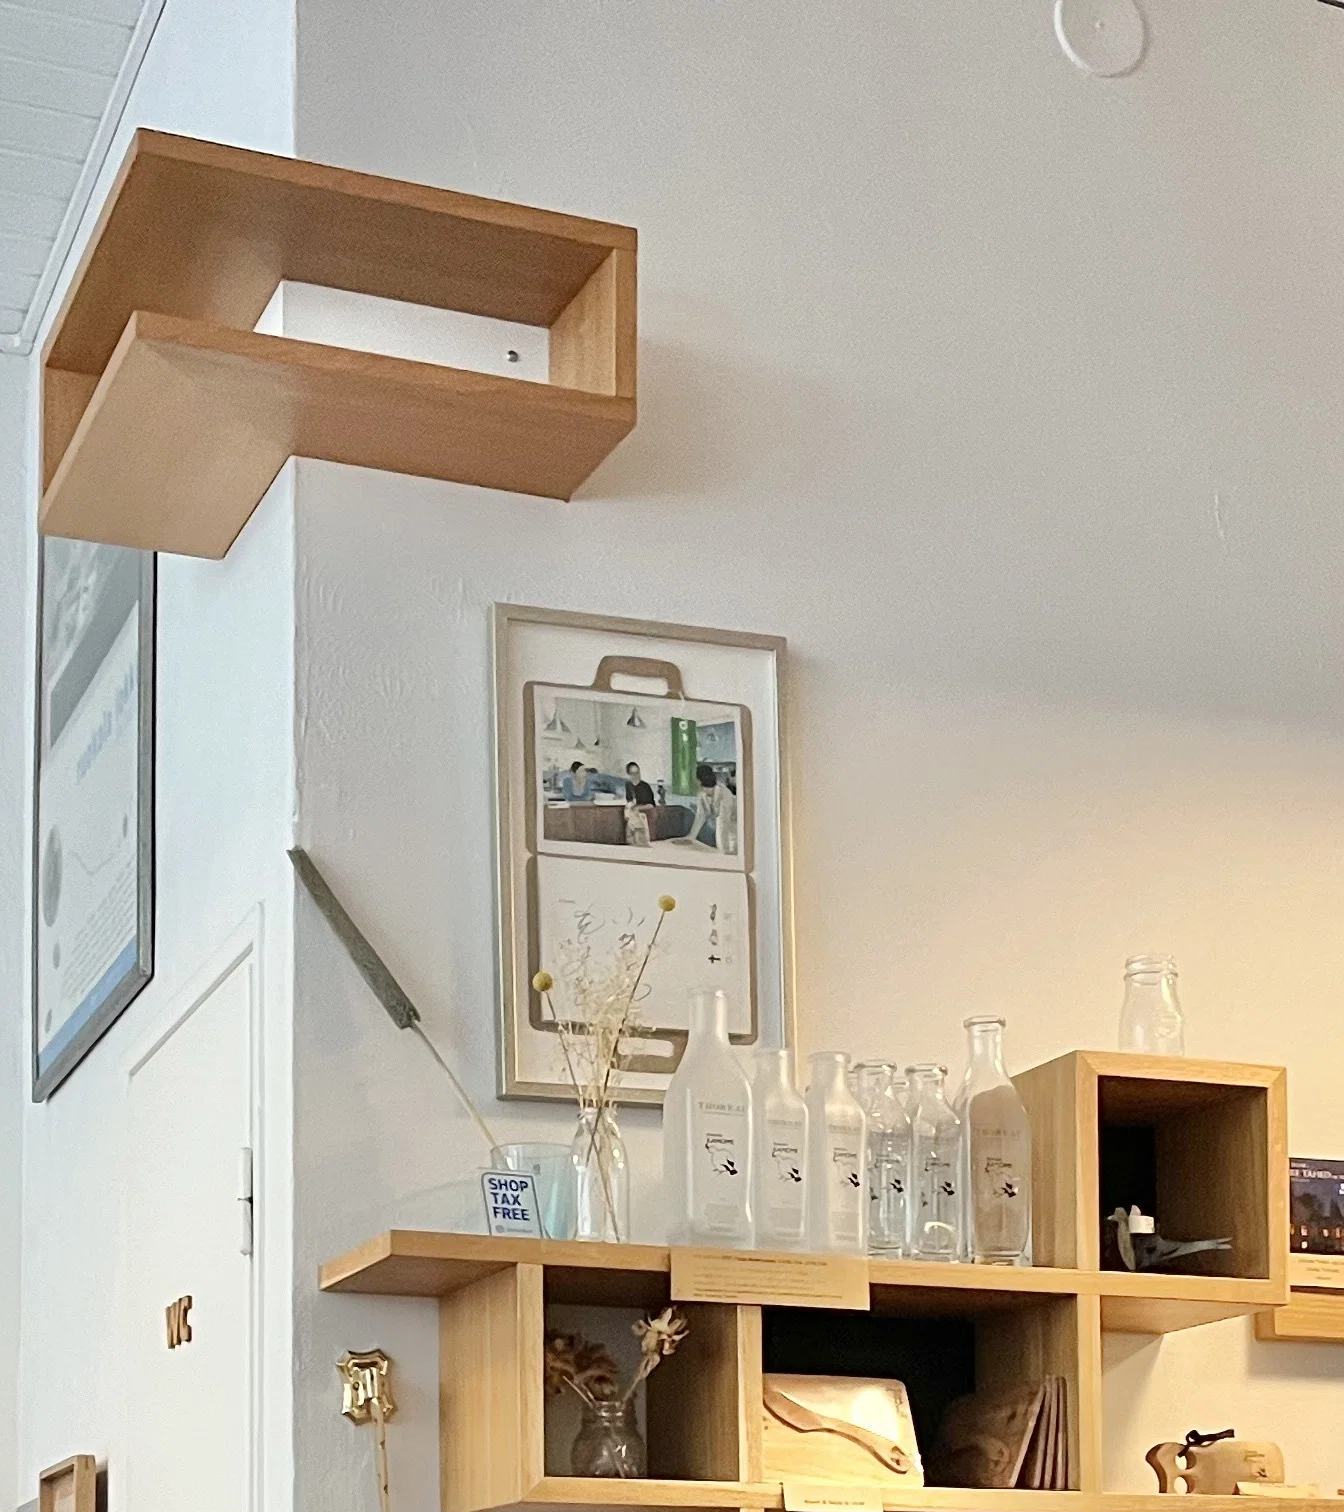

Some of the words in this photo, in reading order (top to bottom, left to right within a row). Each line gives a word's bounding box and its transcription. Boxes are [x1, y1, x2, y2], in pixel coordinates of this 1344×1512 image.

[488, 1178, 529, 1192] SHOP
[490, 1192, 522, 1206] TAX
[492, 1206, 531, 1221] FREE
